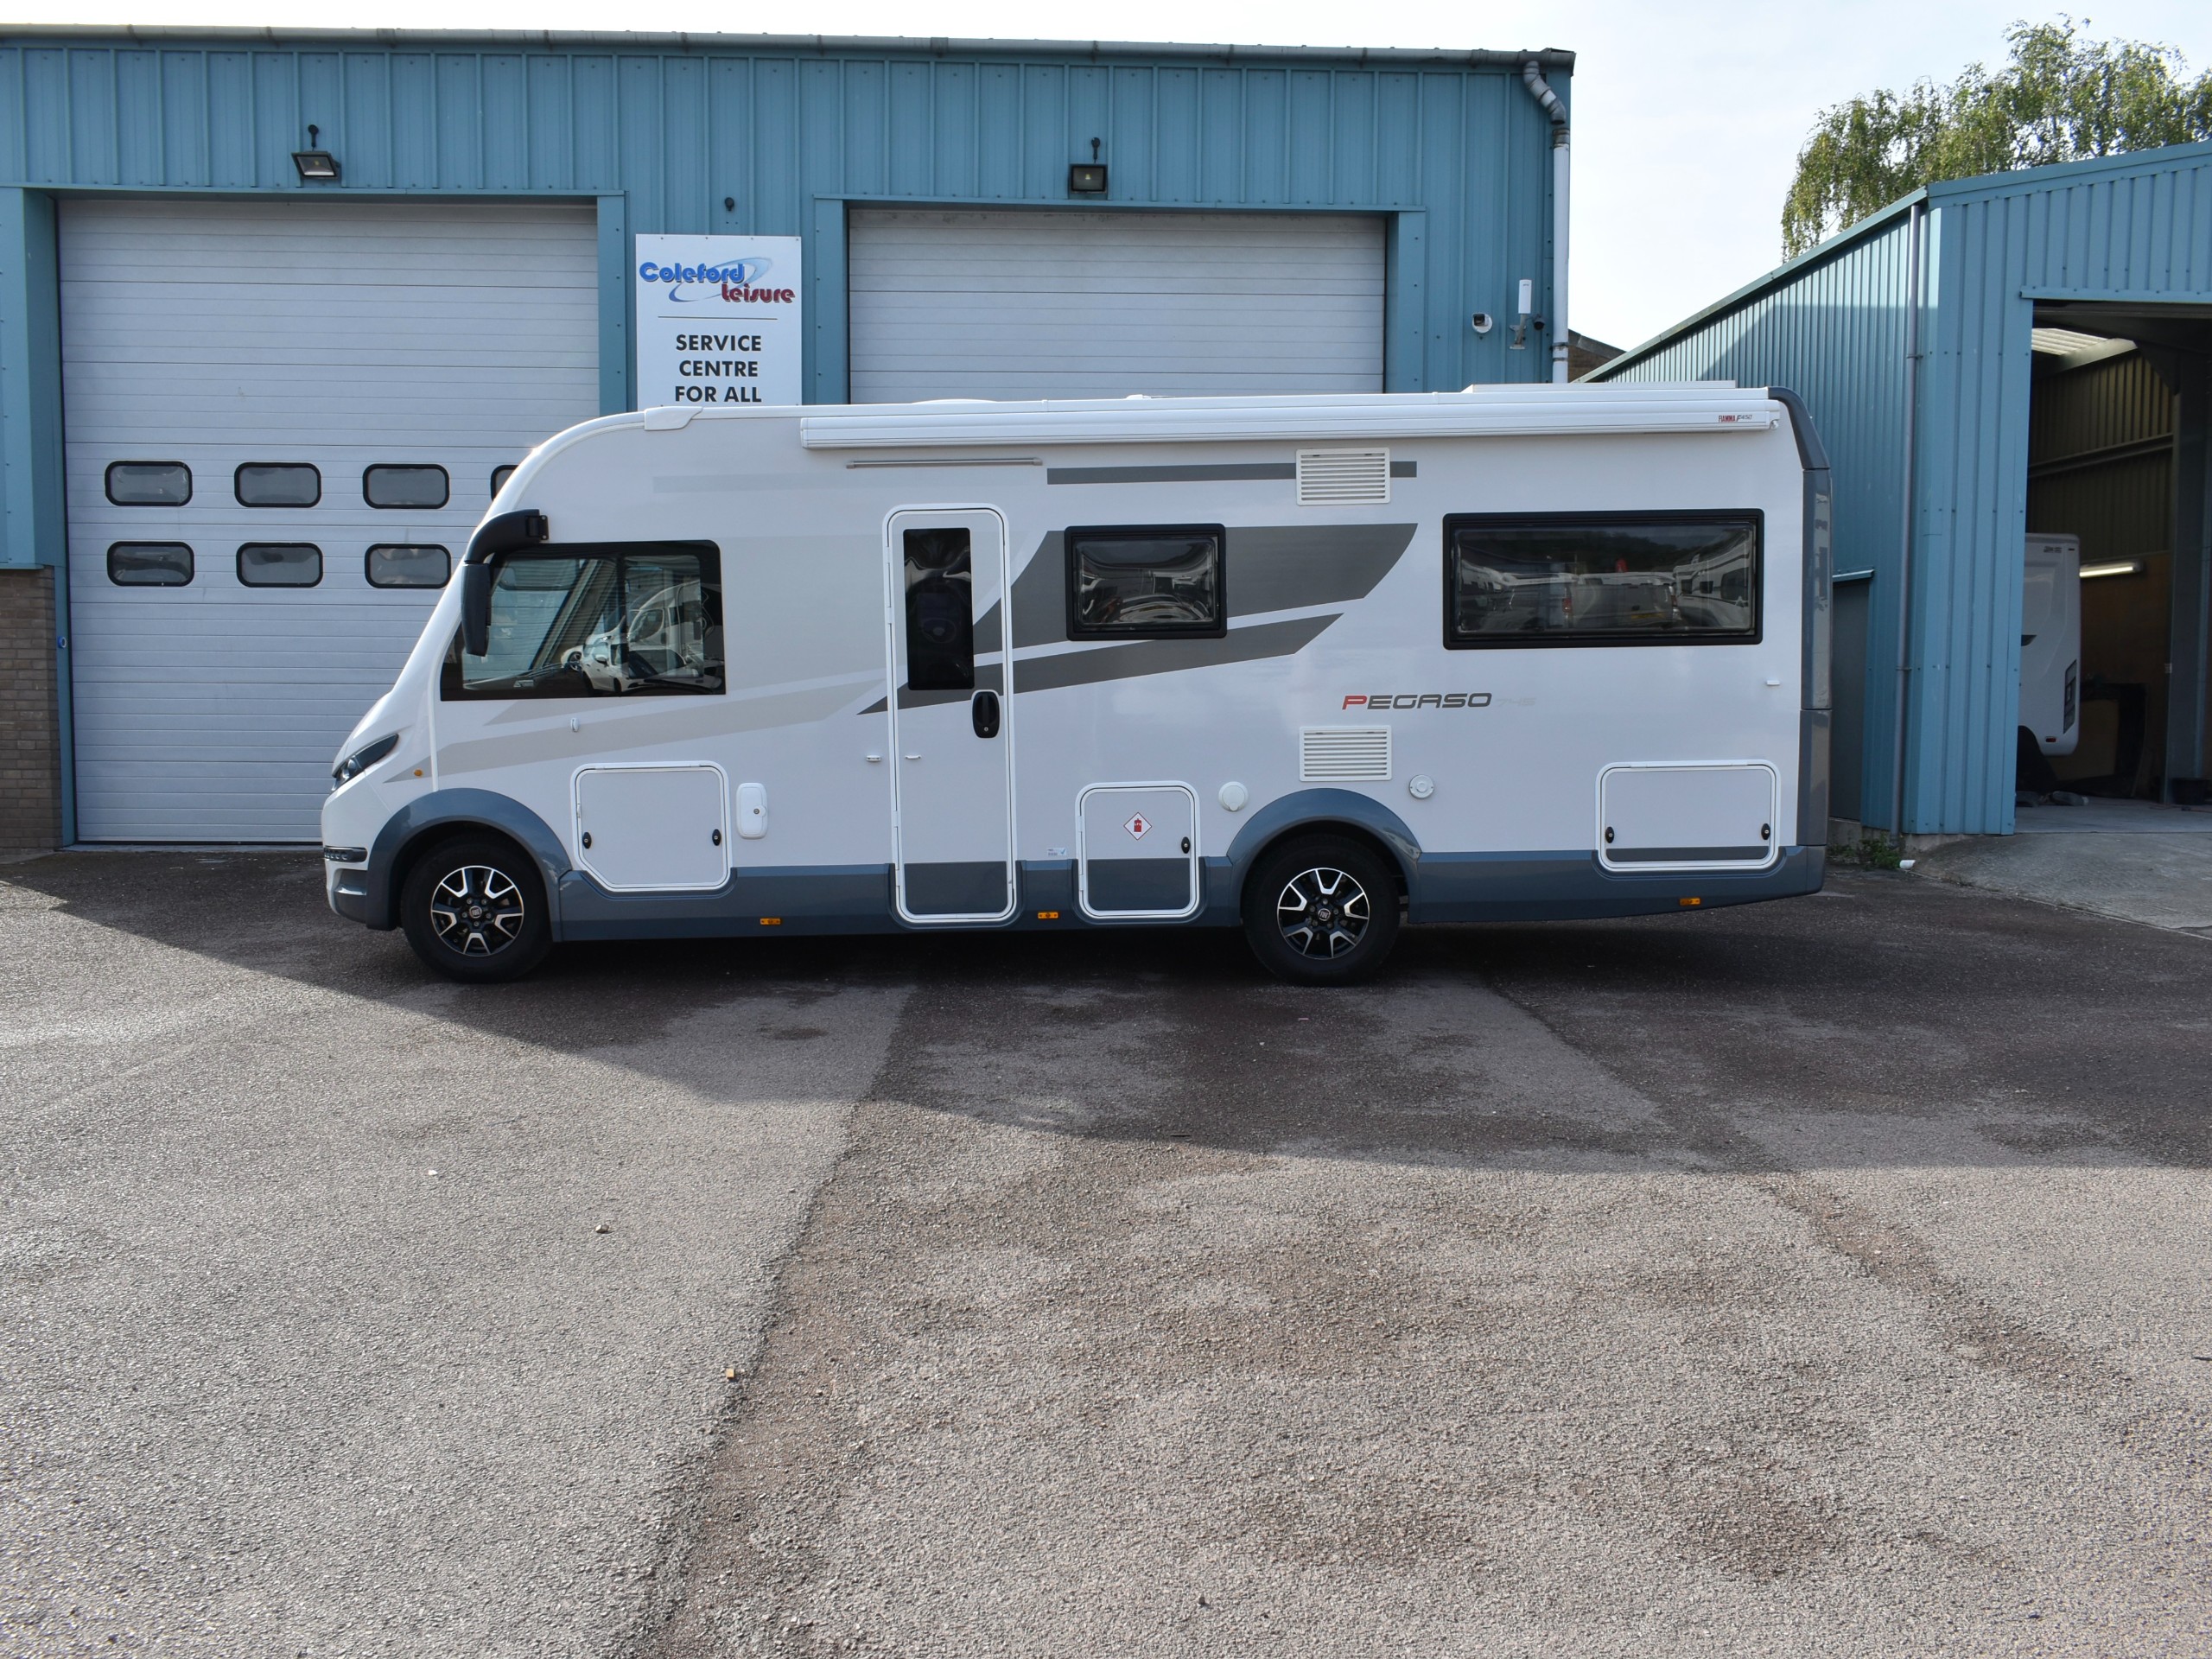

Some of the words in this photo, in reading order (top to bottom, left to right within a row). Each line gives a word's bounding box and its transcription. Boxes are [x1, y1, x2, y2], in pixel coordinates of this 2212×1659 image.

[639, 262, 745, 283] Coleford
[676, 334, 761, 351] SERVICE
[679, 360, 758, 377] CENTRE
[675, 386, 716, 402] FOR
[724, 387, 761, 403] ALL
[1342, 692, 1492, 710] PEGASO
